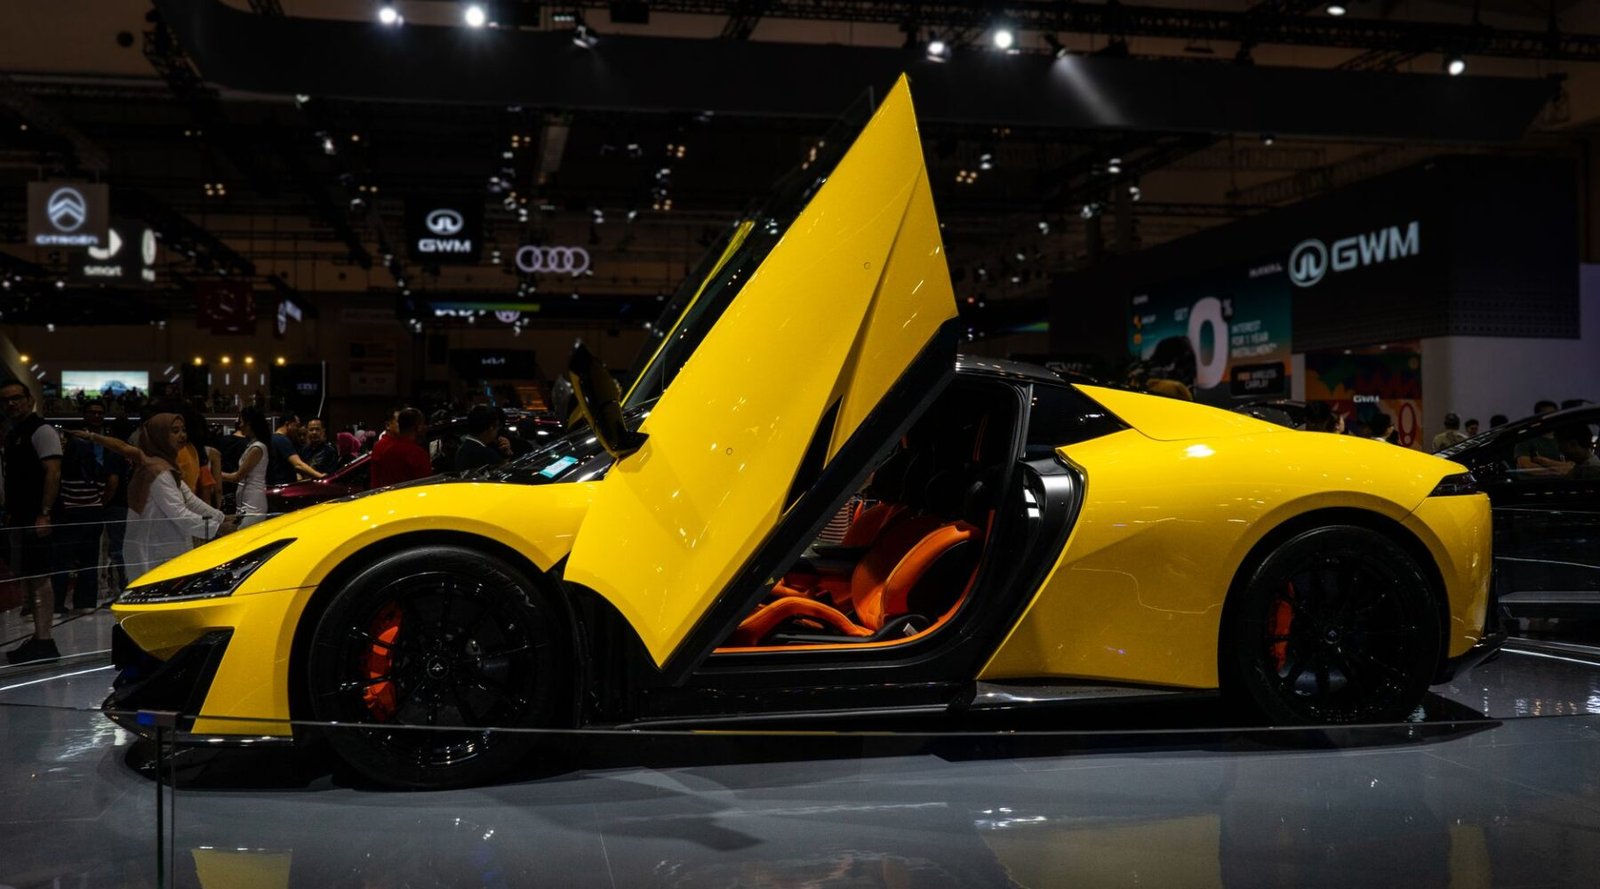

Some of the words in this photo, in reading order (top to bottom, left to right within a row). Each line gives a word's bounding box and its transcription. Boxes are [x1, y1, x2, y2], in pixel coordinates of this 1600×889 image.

[417, 238, 472, 254] GWM
[1330, 219, 1421, 274] GWM
[83, 264, 122, 278] smart
[1188, 296, 1229, 389] 0
